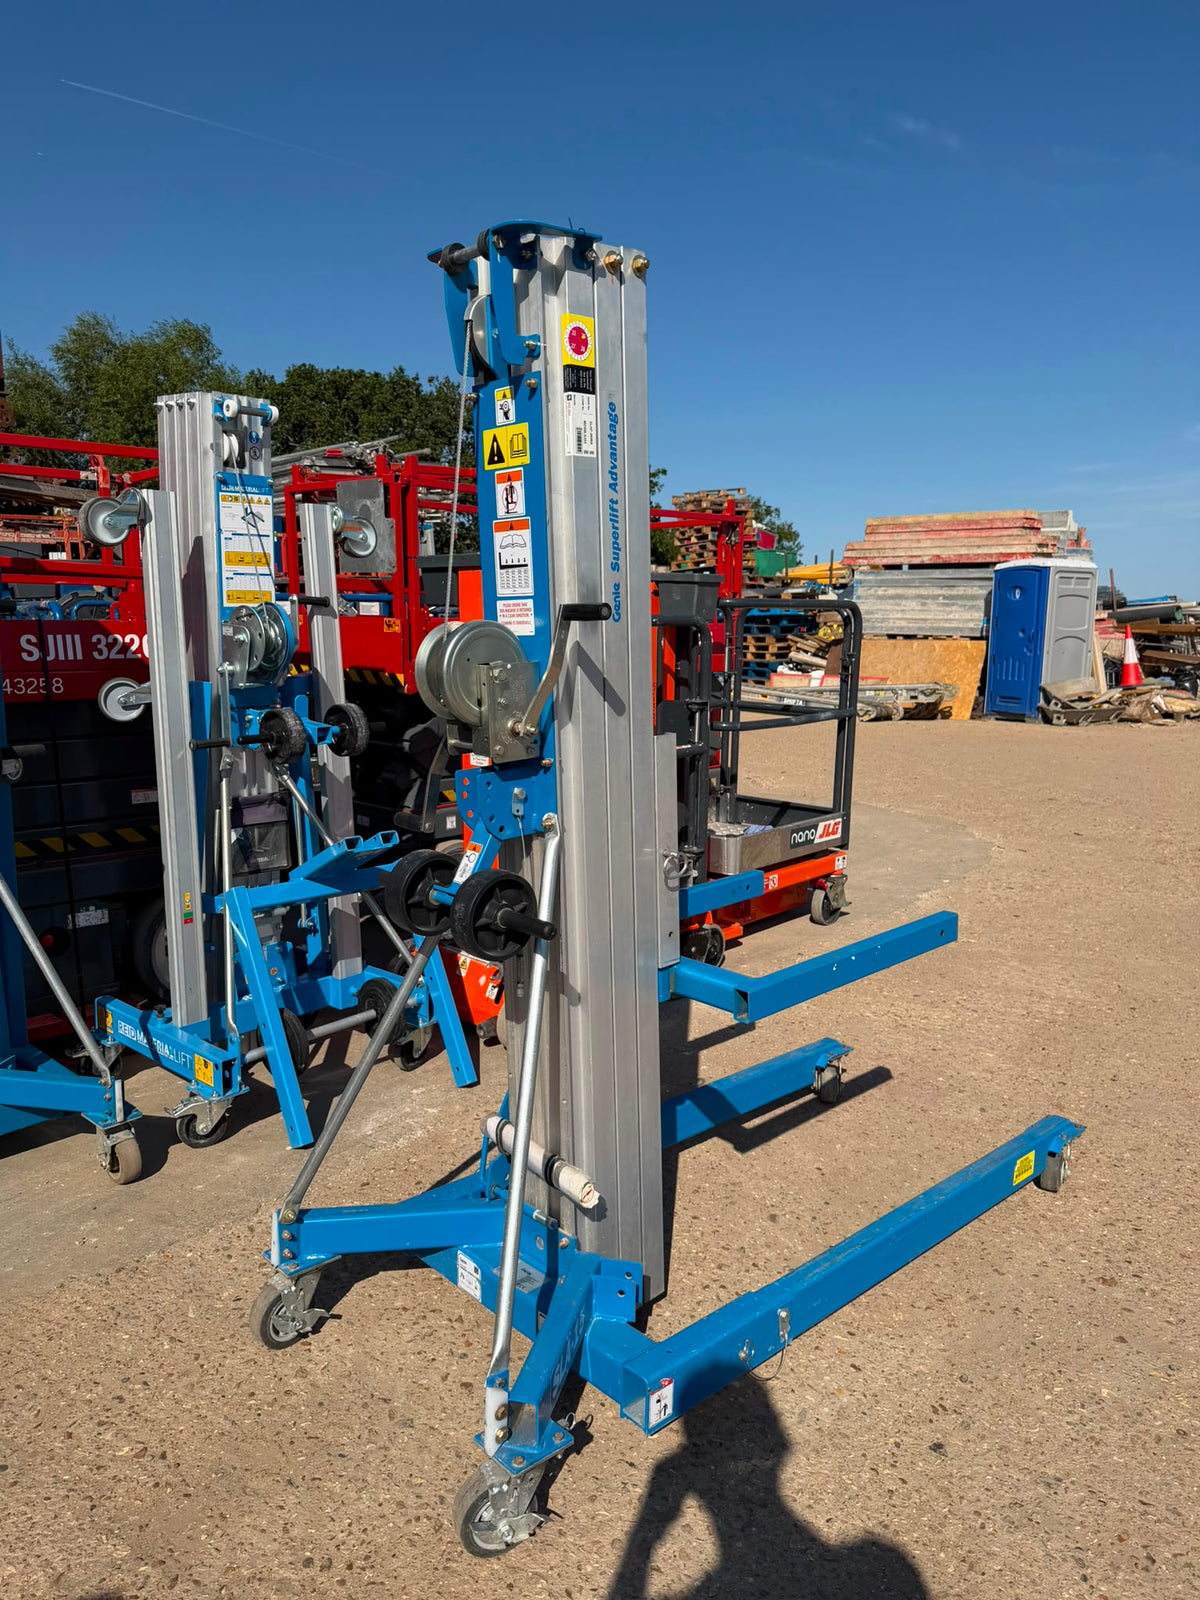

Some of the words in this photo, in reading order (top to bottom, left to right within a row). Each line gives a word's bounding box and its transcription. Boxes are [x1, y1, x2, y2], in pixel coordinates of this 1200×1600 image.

[607, 401, 619, 494] Advantage
[608, 498, 622, 573] Superlift
[612, 582, 621, 623] Genie
[20, 634, 83, 662] SJIII
[791, 828, 816, 845] nano
[818, 820, 841, 840] JLG
